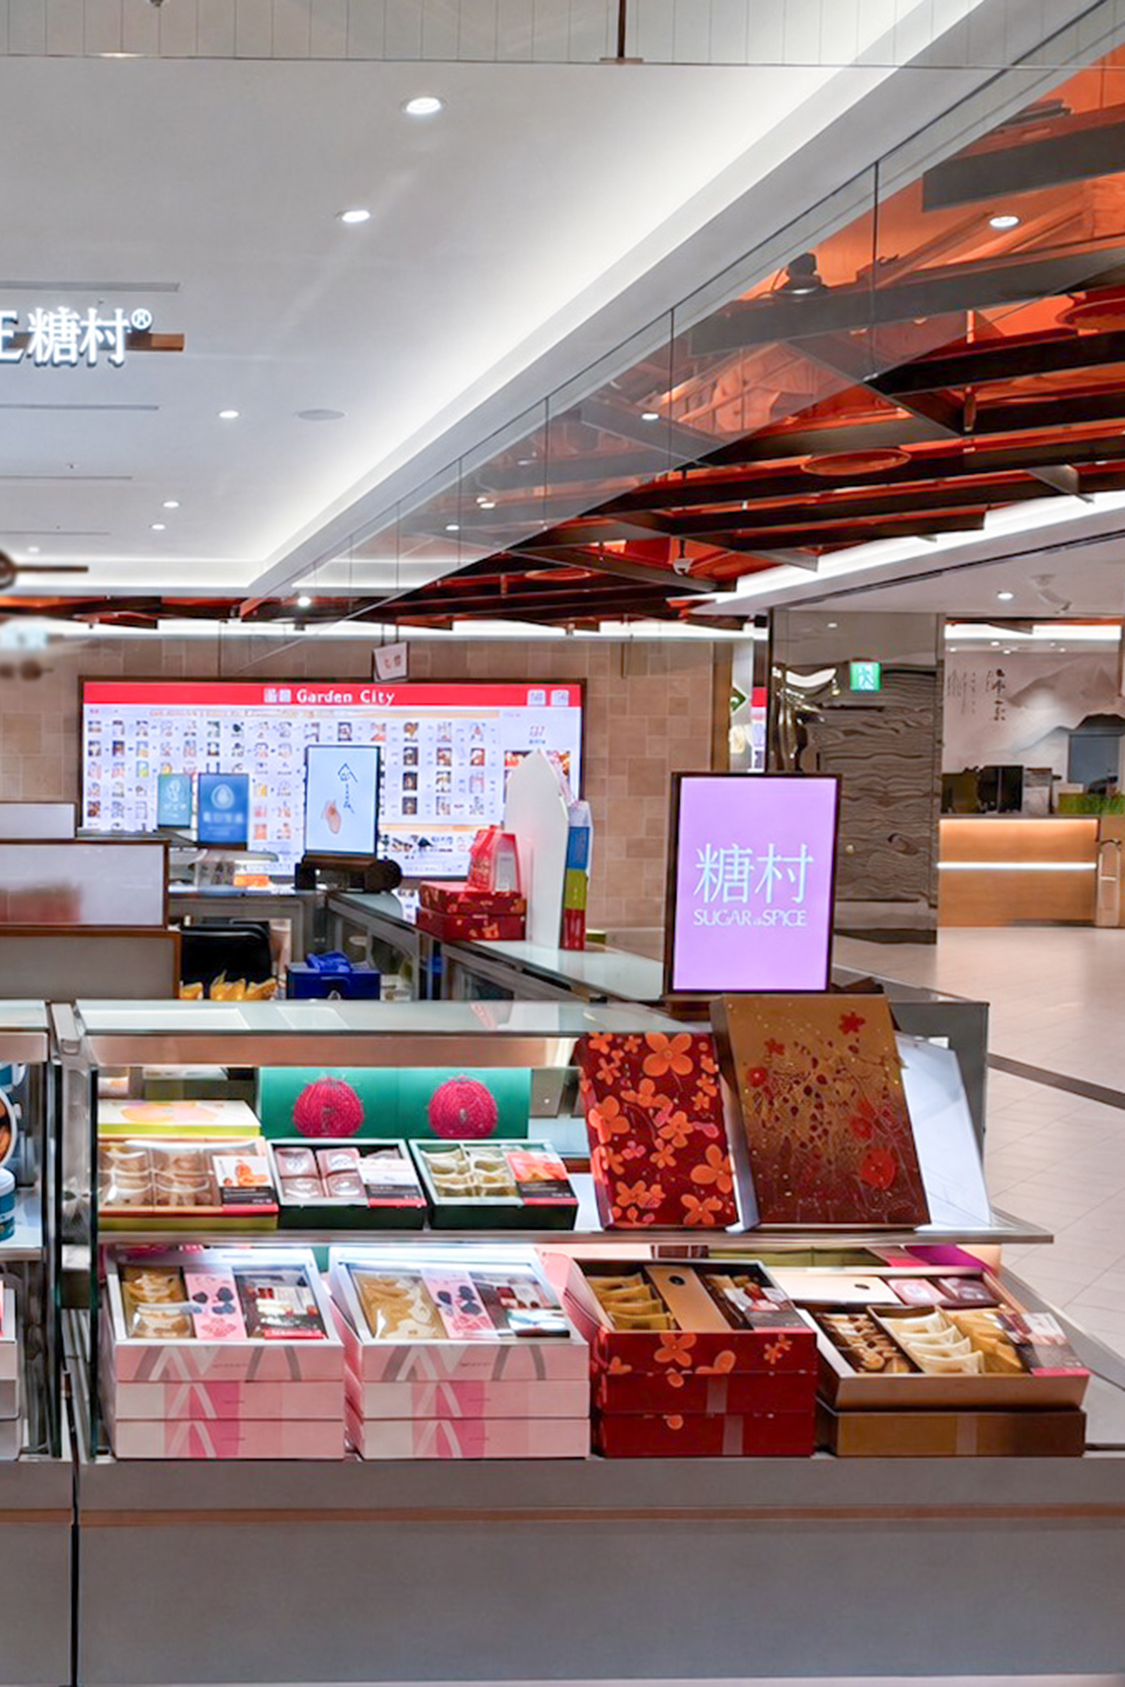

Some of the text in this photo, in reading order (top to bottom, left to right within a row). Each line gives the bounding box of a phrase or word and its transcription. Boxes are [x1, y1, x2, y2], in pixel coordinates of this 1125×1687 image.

[296, 688, 353, 704] Garden
[360, 689, 395, 707] City
[693, 843, 814, 904] 糖村
